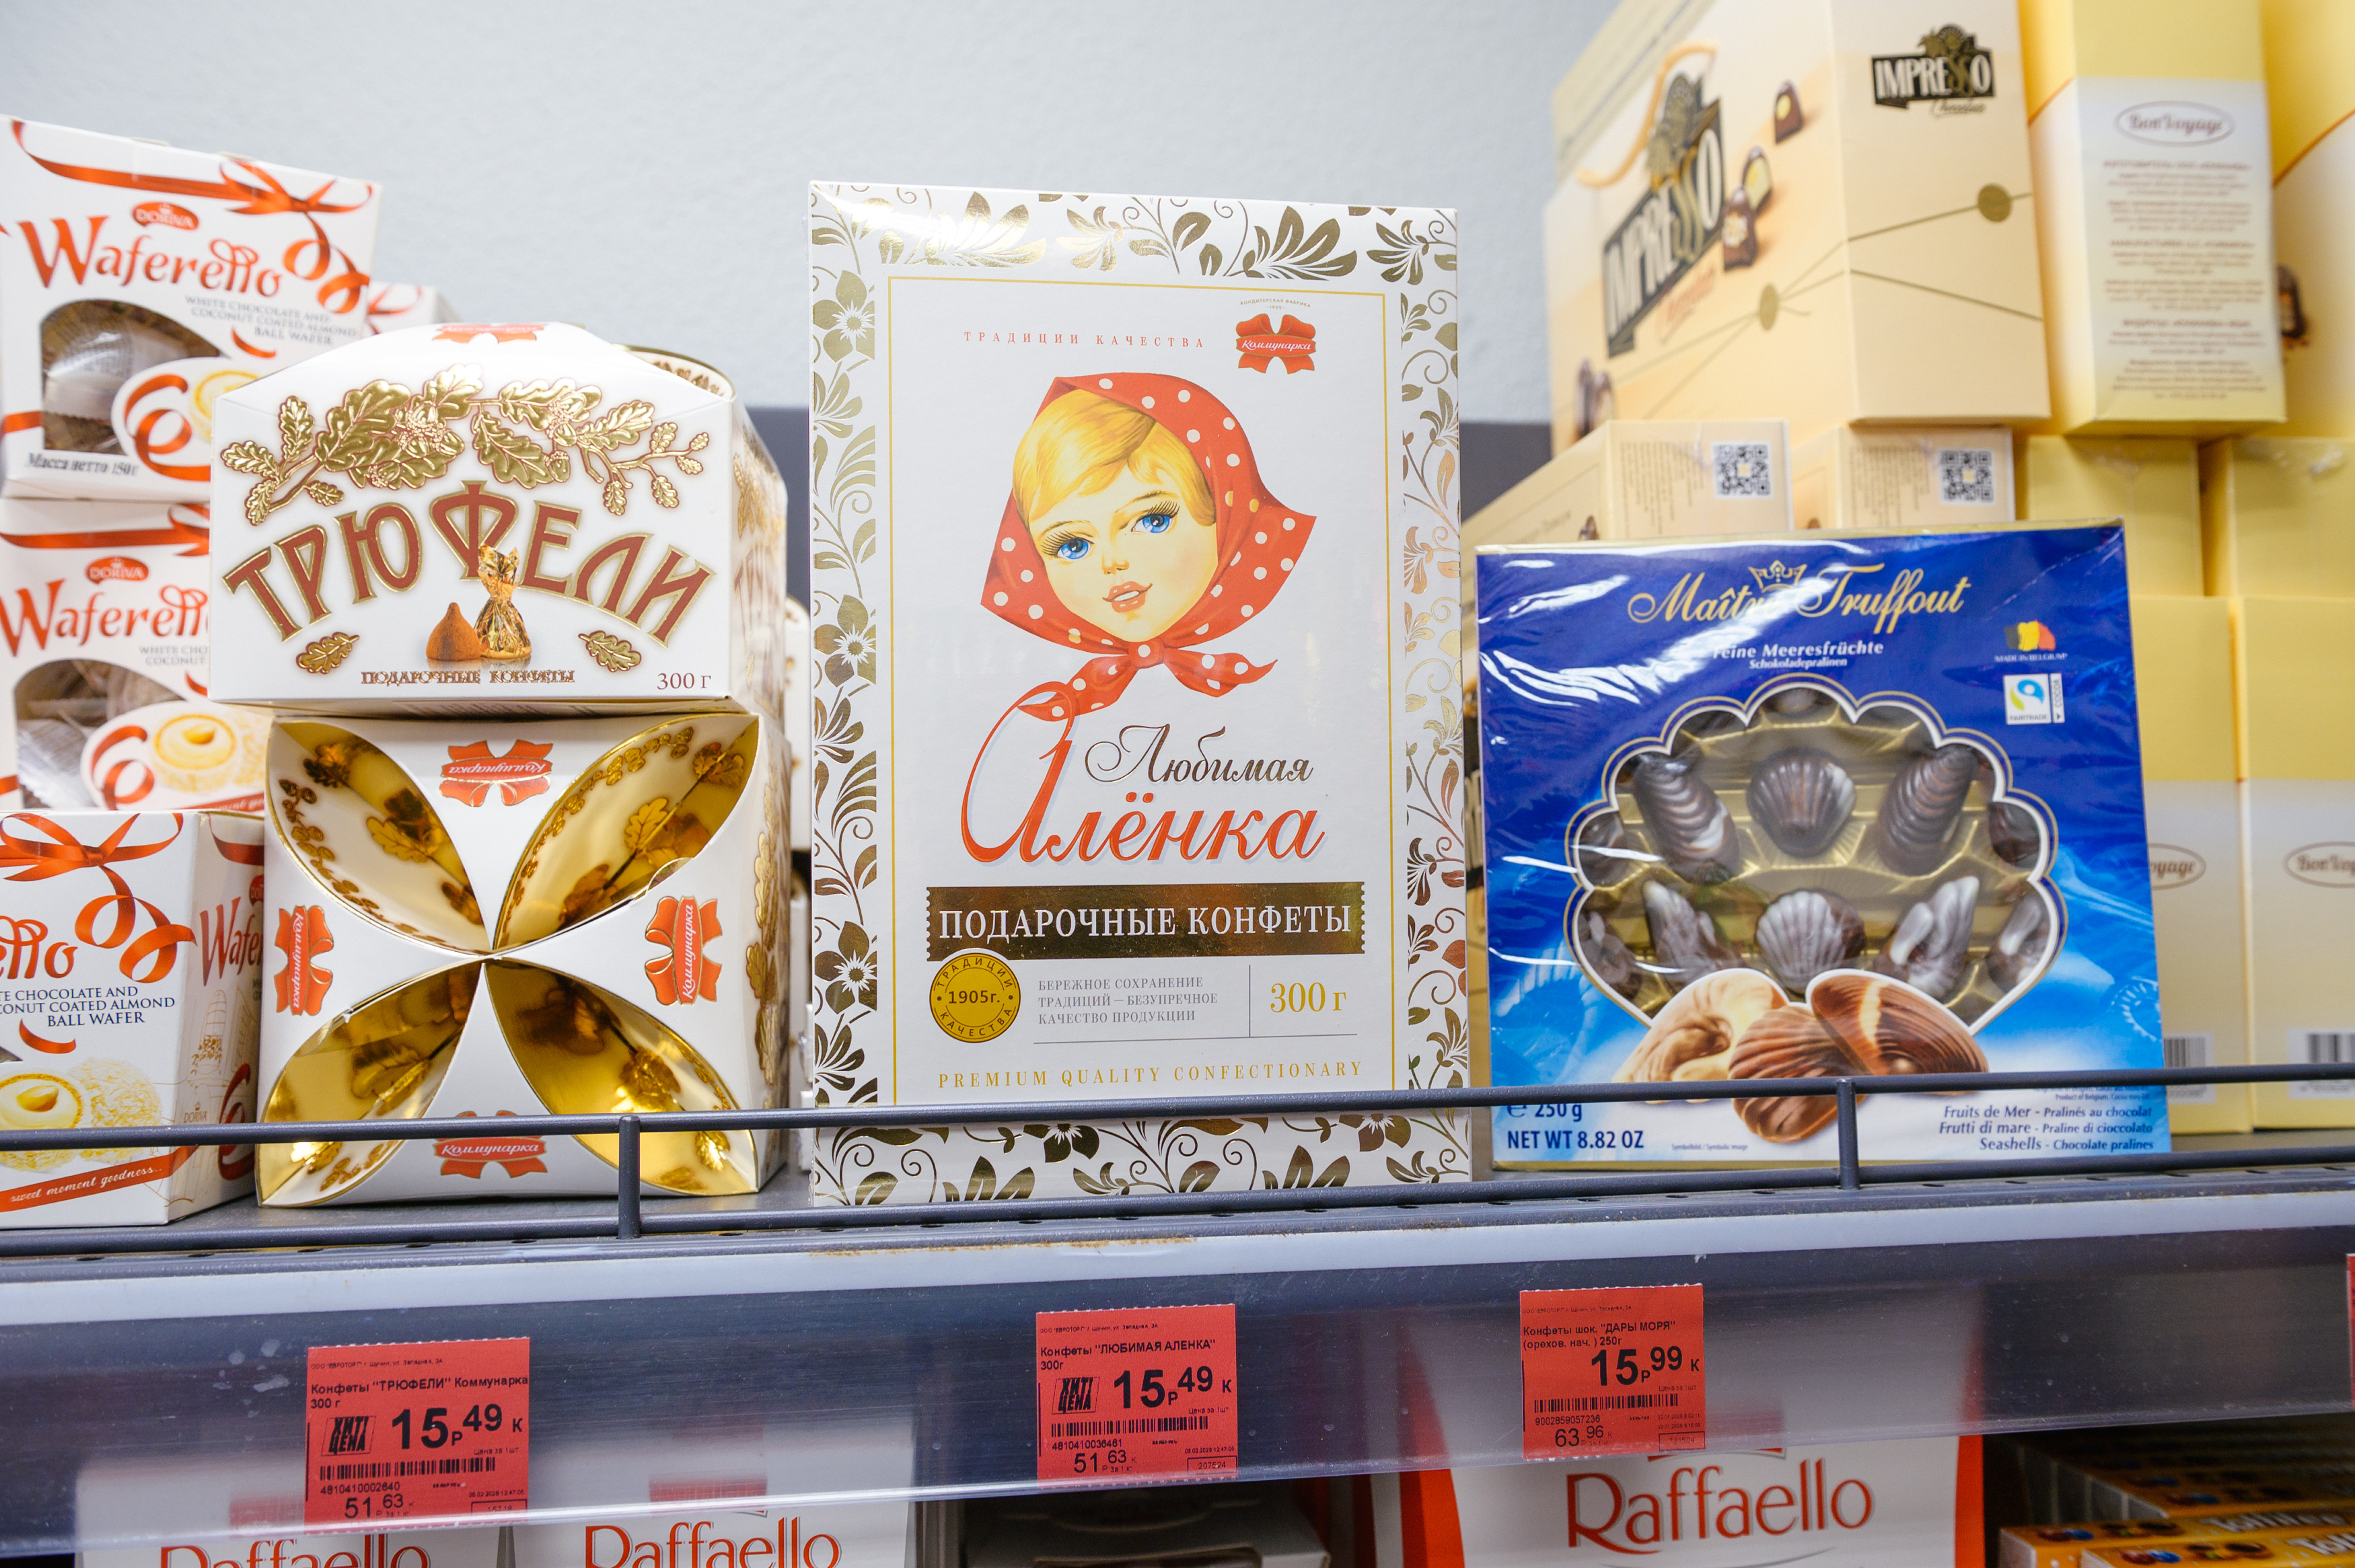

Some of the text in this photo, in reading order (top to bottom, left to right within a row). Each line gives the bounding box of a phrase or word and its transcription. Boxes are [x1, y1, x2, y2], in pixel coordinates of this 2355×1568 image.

[17, 215, 283, 297] Waferello
[1285, 299, 1311, 307] ФАБРИКА
[964, 332, 1204, 348] ТРАДИЦИИ КАЧЕСТВА
[1241, 340, 1311, 352] Коммунарка
[89, 566, 145, 579] DORIVA
[221, 480, 717, 648] ТРЮФЕЛИ
[1794, 562, 1972, 635] Truffout
[0, 579, 209, 657] Waferell
[1763, 640, 1884, 659] Meeresfrüchte
[1749, 656, 1848, 670] Schokoladepralinen
[361, 669, 576, 686] ПОДАРОЧНЫЕ КОНФЕТЫ
[657, 672, 712, 690] 300 г
[1084, 723, 1313, 783] Любимая
[448, 761, 547, 775] Коммунарка
[960, 689, 1326, 863] Алёнка
[939, 903, 1352, 944] ПОДАРОЧНЫЕ КОНФЕТЫ
[291, 911, 305, 1009] Коммунарка
[680, 903, 695, 1000] Коммунарка
[937, 957, 1013, 988] ТРАДИЦИИ
[15, 987, 102, 1001] CHOCOLATE
[106, 986, 139, 997] AND
[1038, 977, 1204, 991] БЕРЕЖНОЕ СОХРАНЕНИЕ
[49, 1000, 106, 1012] COATED
[111, 997, 175, 1010] ALMOND
[947, 990, 1001, 1004] 1905г.
[1038, 992, 1218, 1008] ТРАДИЦИЙ БЕЗУПРЕЧНОЕ
[1269, 981, 1346, 1013] 300 г
[47, 1011, 146, 1027] BALL WAFER
[939, 1006, 1013, 1037] КАЧЕСТВА
[1038, 1010, 1196, 1025] КАЧЕСТВО ПРОДУКЦИИ
[938, 1060, 1363, 1088] PREMIUM QUALITY CONFECTIONARY
[1534, 1103, 1582, 1123] 250 g
[1944, 1105, 2152, 1118] Fruits de Mer Pralinés au chocolat
[1939, 1120, 2153, 1134] Frutti di mare Praline di cioccolato
[441, 1138, 540, 1157] Коммунарка
[1507, 1130, 1644, 1149] NET WT 8.82 OZ
[1980, 1136, 2154, 1152] Seashells Chocolate pralines
[10, 1188, 42, 1202] sweet
[46, 1177, 97, 1197] moment
[1523, 1320, 1675, 1337] Конфеты шок. "ДАРЫ МОРЯ"
[1040, 1339, 1216, 1358] Конфеты "ЛЮБИМАЯ АЛЕНКА"
[1523, 1336, 1622, 1351] (орехов. нач. 250г
[1040, 1360, 1064, 1370] 300г
[1591, 1348, 1638, 1386] 15
[1650, 1345, 1683, 1372] 99
[311, 1376, 528, 1396] Конфеты "ТРЮФЕЛИ" Коммунарка
[1114, 1369, 1166, 1409] 15
[1178, 1366, 1213, 1392] 49
[1222, 1379, 1232, 1393] К
[311, 1398, 340, 1409] 300 г
[1058, 1393, 1092, 1413] ЦЕНА
[391, 1407, 449, 1450] 15
[462, 1403, 503, 1431] 49
[512, 1417, 523, 1433] К
[1535, 1414, 1601, 1426] 9002859057236
[328, 1434, 366, 1456] ЦЕНА
[1051, 1439, 1122, 1451] 4810410036461
[1555, 1425, 1604, 1447] 63 96
[1073, 1450, 1127, 1473] 51 63
[320, 1482, 400, 1495] 4810410002640
[344, 1494, 404, 1519] 51 63
[1566, 1458, 1873, 1555] Raffaello
